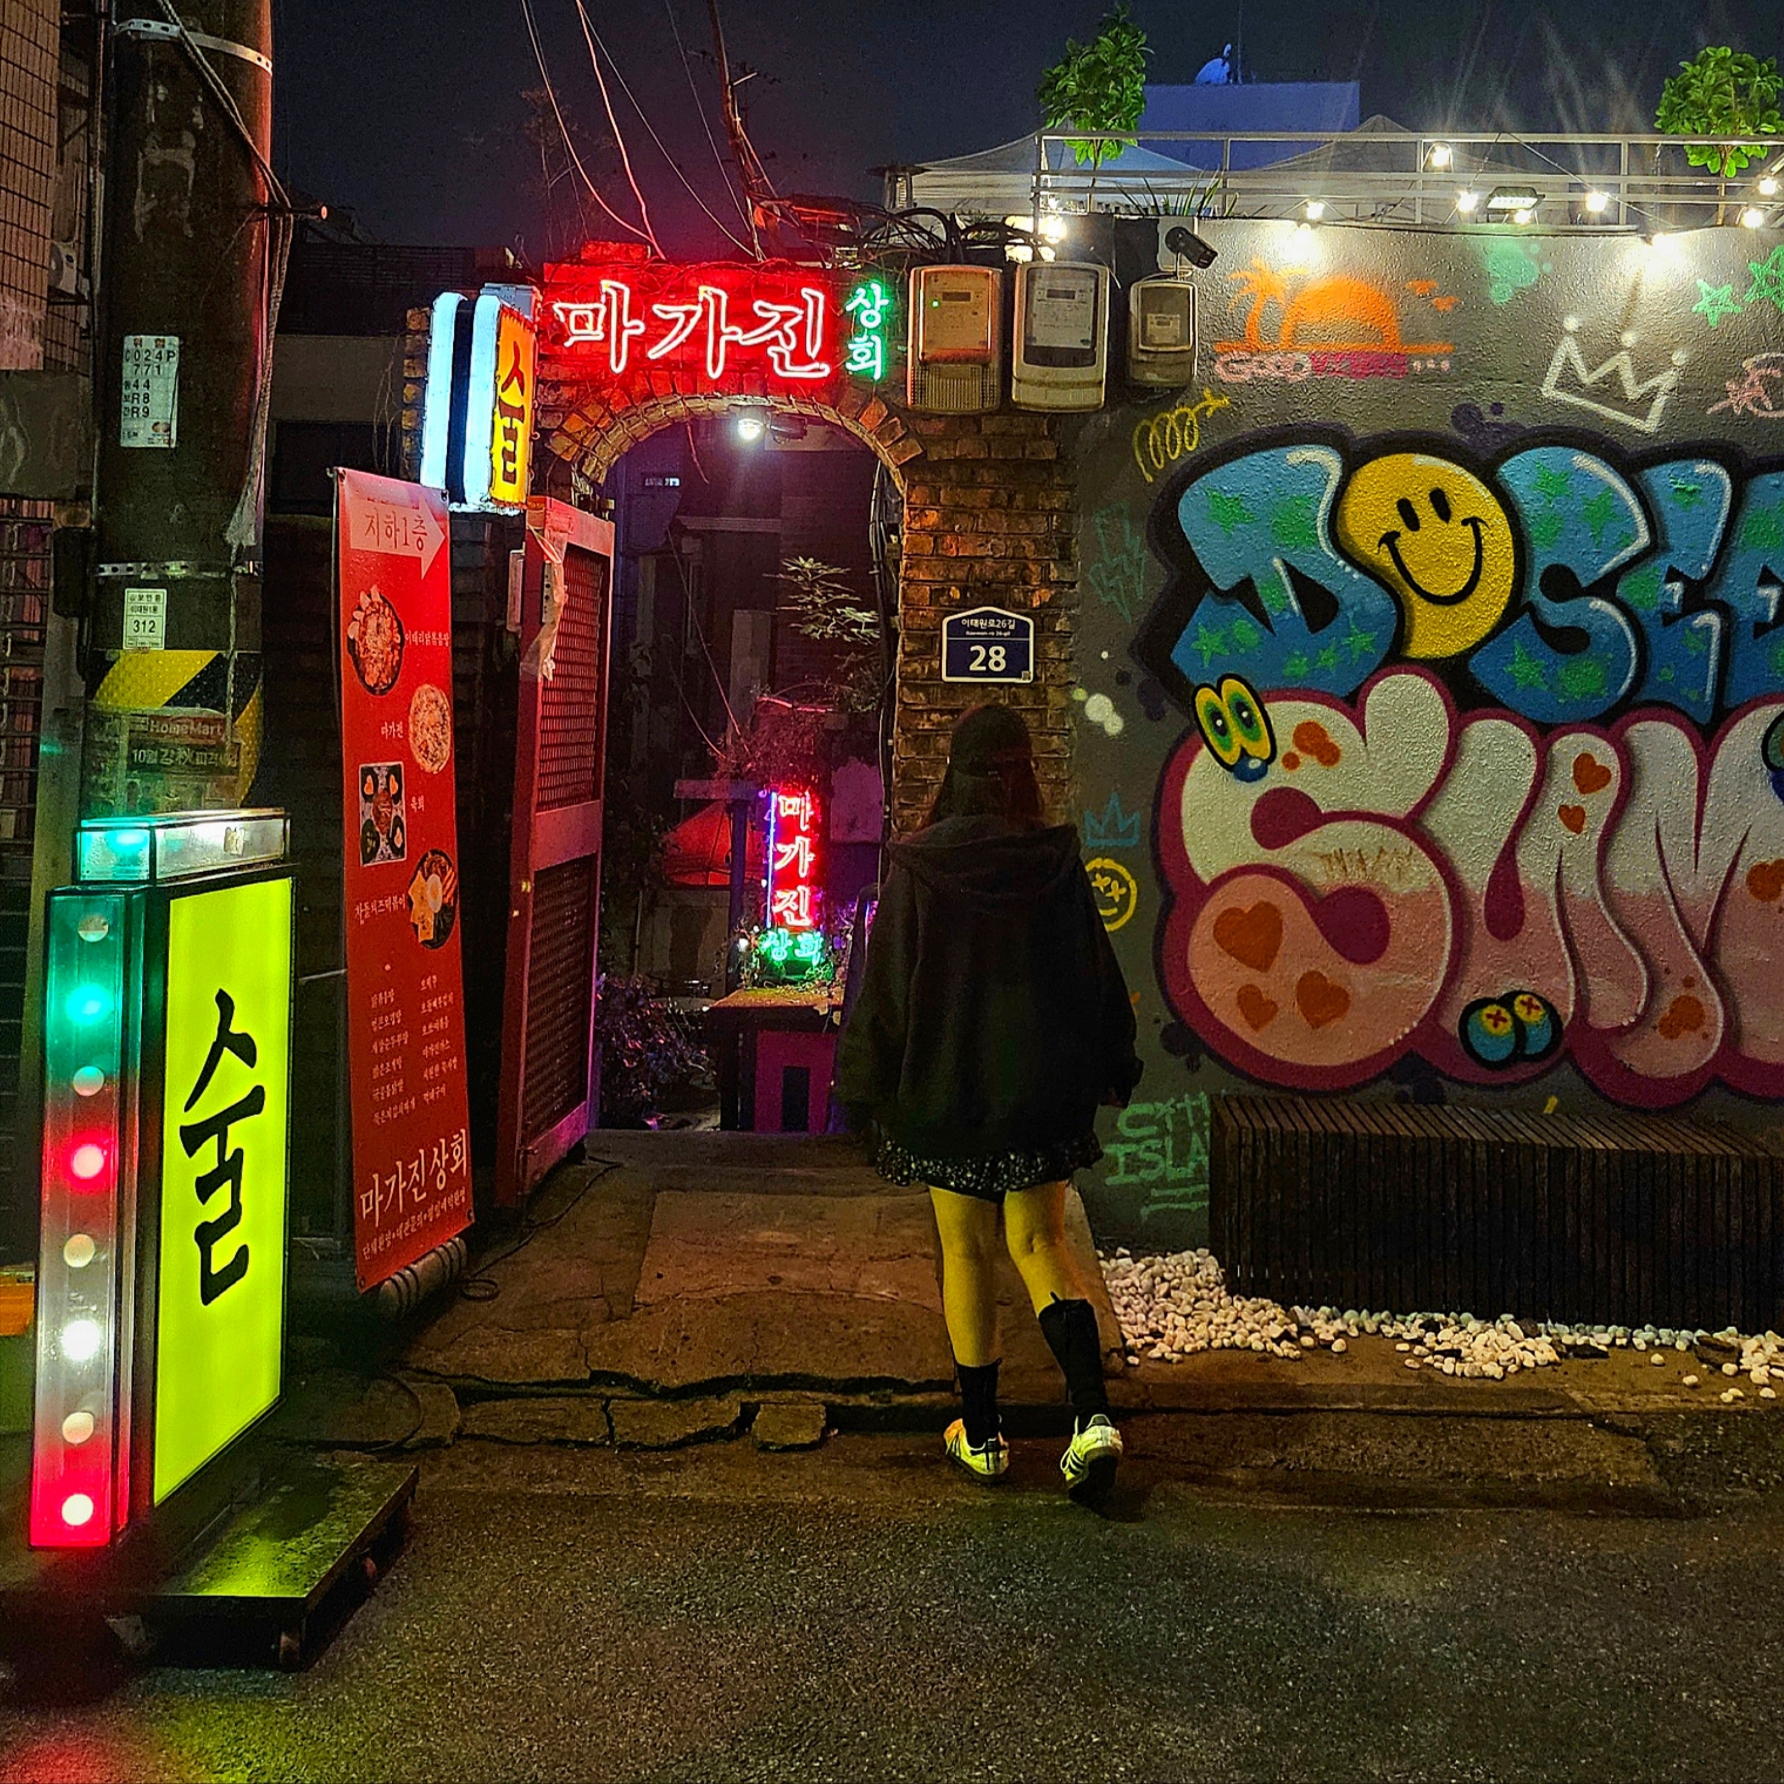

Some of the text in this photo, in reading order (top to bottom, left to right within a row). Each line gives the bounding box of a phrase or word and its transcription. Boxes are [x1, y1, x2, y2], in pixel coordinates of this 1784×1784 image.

[552, 279, 830, 379] 마가진
[846, 283, 889, 380] 상회
[364, 506, 428, 552] 지하1층
[133, 619, 156, 634] 312
[961, 618, 1016, 630] 이태원로26길
[969, 645, 1007, 672] 28
[150, 719, 224, 736] HomeMart
[410, 795, 426, 812] 육회
[771, 791, 815, 927] 마가진
[761, 928, 824, 967] 상회
[179, 987, 266, 1306] 술
[360, 1128, 467, 1228] 마가진상회
